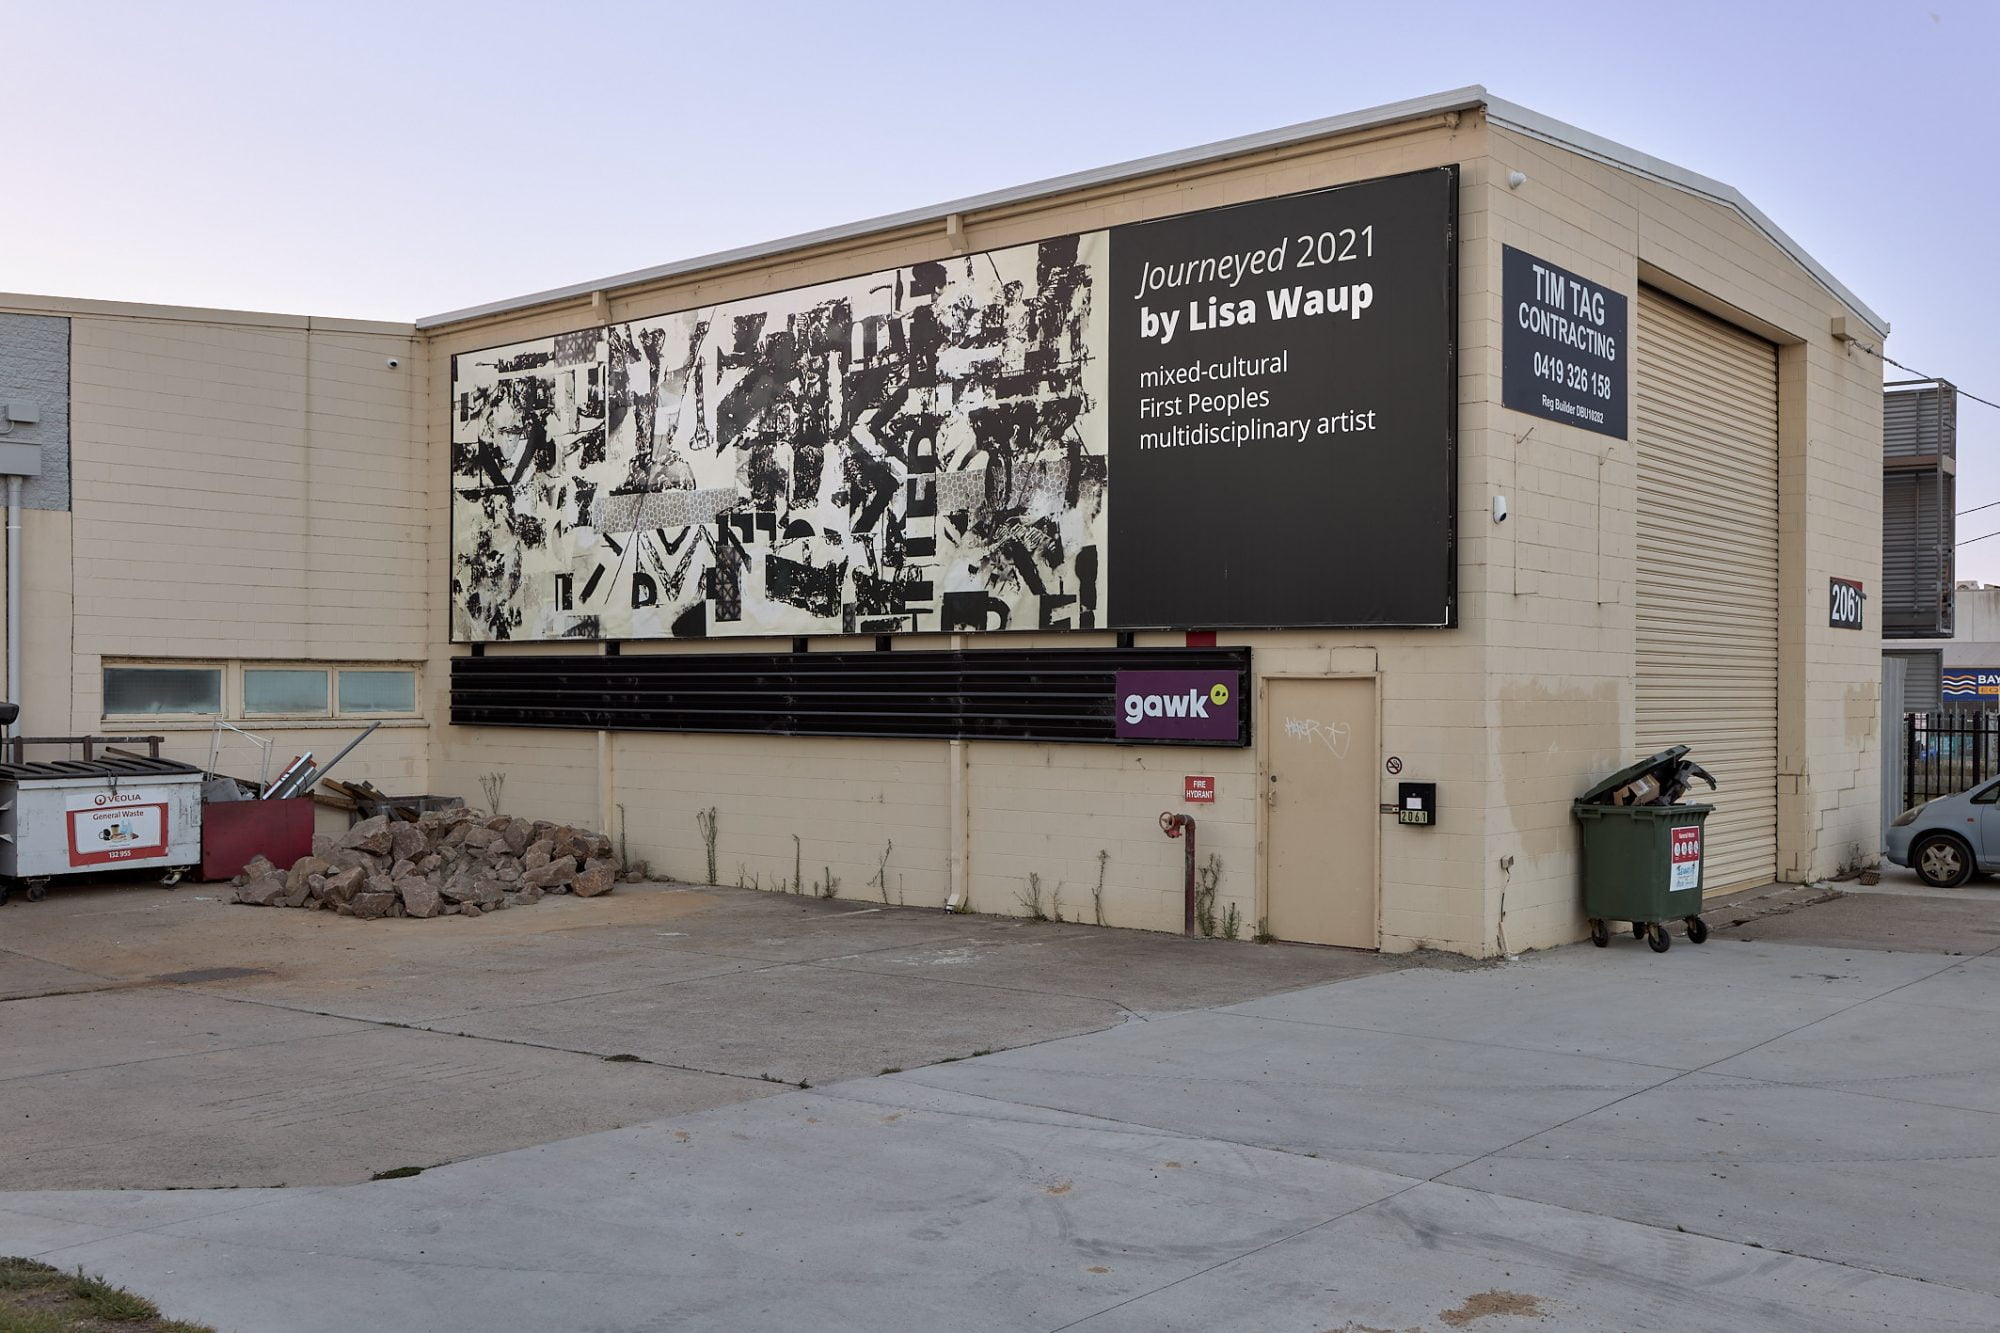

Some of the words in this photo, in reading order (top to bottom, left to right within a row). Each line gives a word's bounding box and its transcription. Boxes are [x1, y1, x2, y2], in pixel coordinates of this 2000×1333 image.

[1134, 237, 1288, 299] Journeyed
[1296, 225, 1373, 268] 2021
[1140, 306, 1180, 345] by
[1189, 296, 1256, 331] Lisa
[1266, 281, 1373, 320] Waup
[1532, 264, 1564, 311] TIM
[1570, 280, 1605, 326] TAG
[1518, 302, 1615, 361] CONTRACTING
[1140, 350, 1288, 388] mixed-cultural
[1533, 351, 1563, 384] 0419
[1567, 363, 1587, 392] 326
[1591, 371, 1611, 400] 158
[1140, 395, 1182, 419] First
[1188, 388, 1270, 416] Peoples
[1542, 394, 1554, 411] Reg
[1555, 398, 1575, 415] Builder
[1140, 418, 1311, 449] multidisciplinary
[1317, 408, 1376, 434] artist
[1831, 584, 1861, 623] 2061
[1124, 688, 1209, 724] gawk
[107, 794, 141, 803] VEOLIA
[1186, 790, 1213, 799] HYDRANT
[1193, 780, 1206, 789] FIRE
[92, 811, 120, 821] General
[121, 809, 144, 818] Waste
[1401, 811, 1426, 822] 2061
[108, 851, 119, 859] 132
